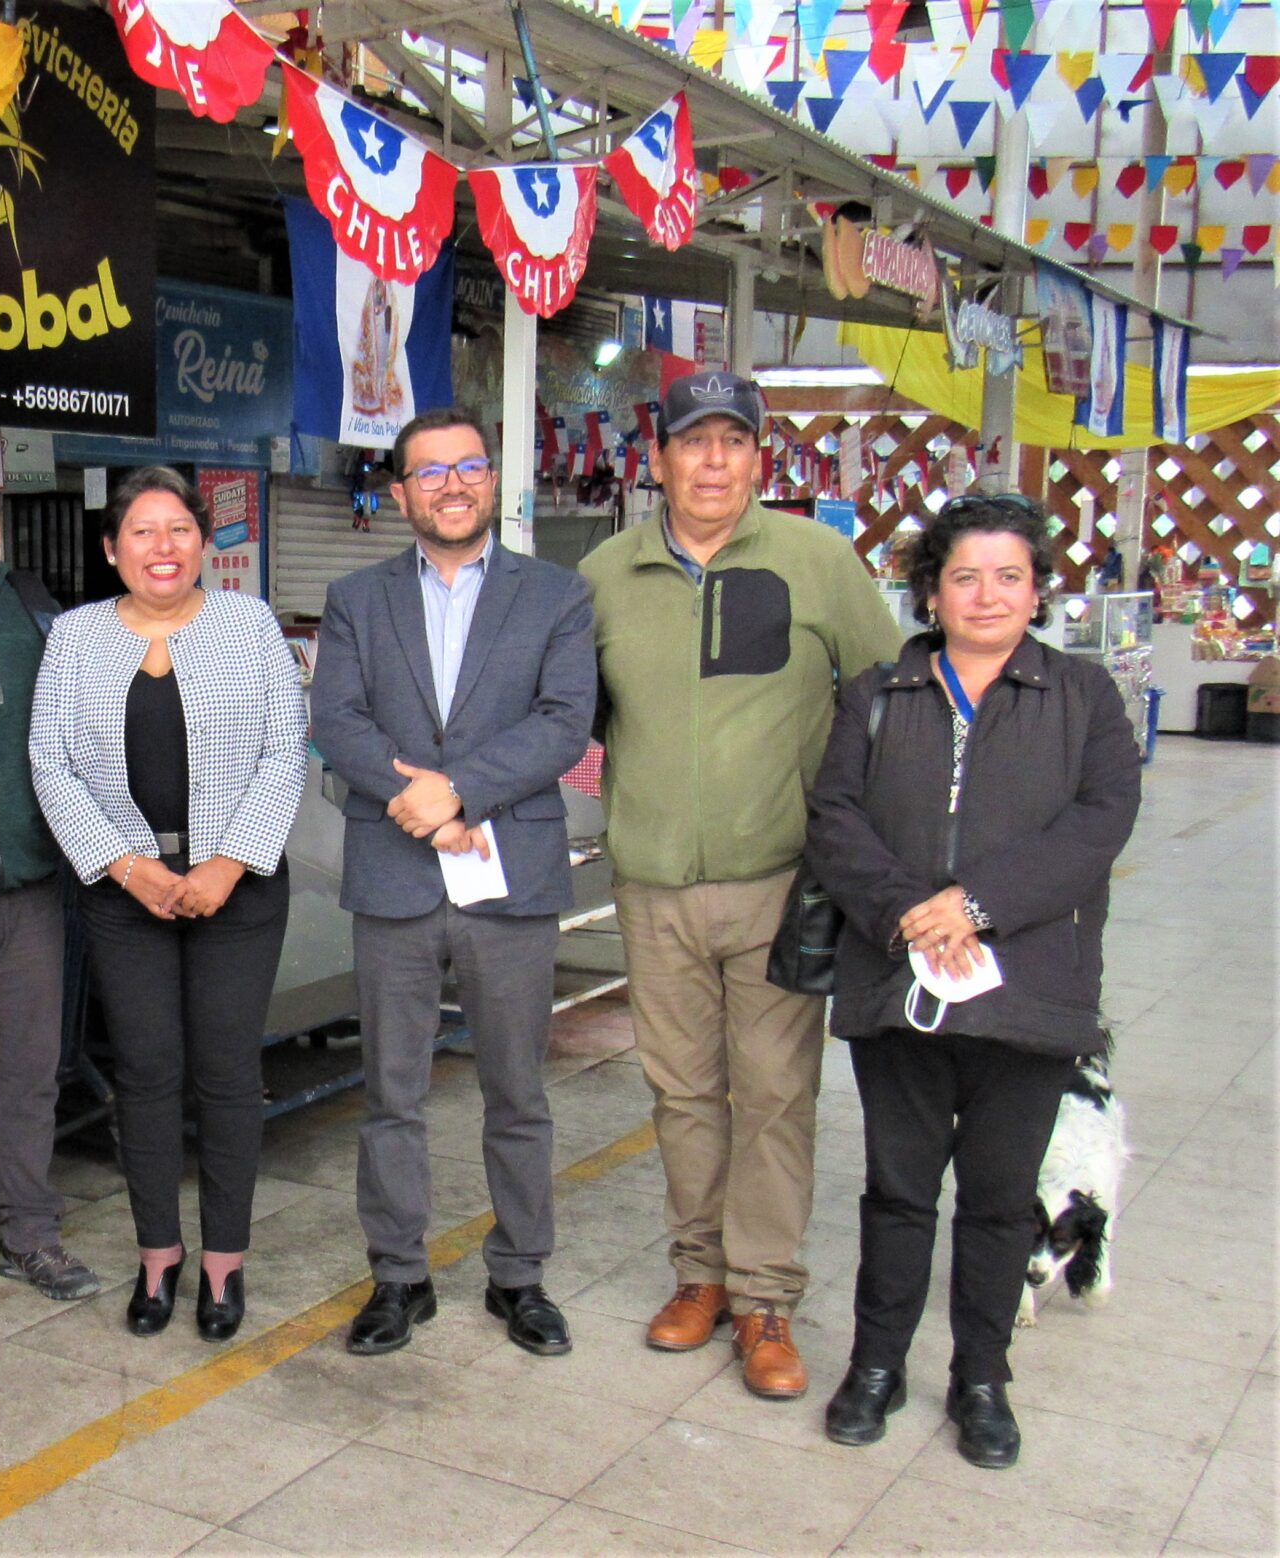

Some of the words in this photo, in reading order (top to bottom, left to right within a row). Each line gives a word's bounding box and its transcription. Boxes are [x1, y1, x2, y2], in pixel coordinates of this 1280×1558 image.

[326, 176, 422, 271] CHILE
[654, 168, 697, 243] CHILE
[507, 253, 579, 306] CHILE
[174, 329, 266, 403] Reina
[12, 384, 129, 417] +56986710171
[354, 419, 370, 433] Viva
[371, 421, 385, 437] San
